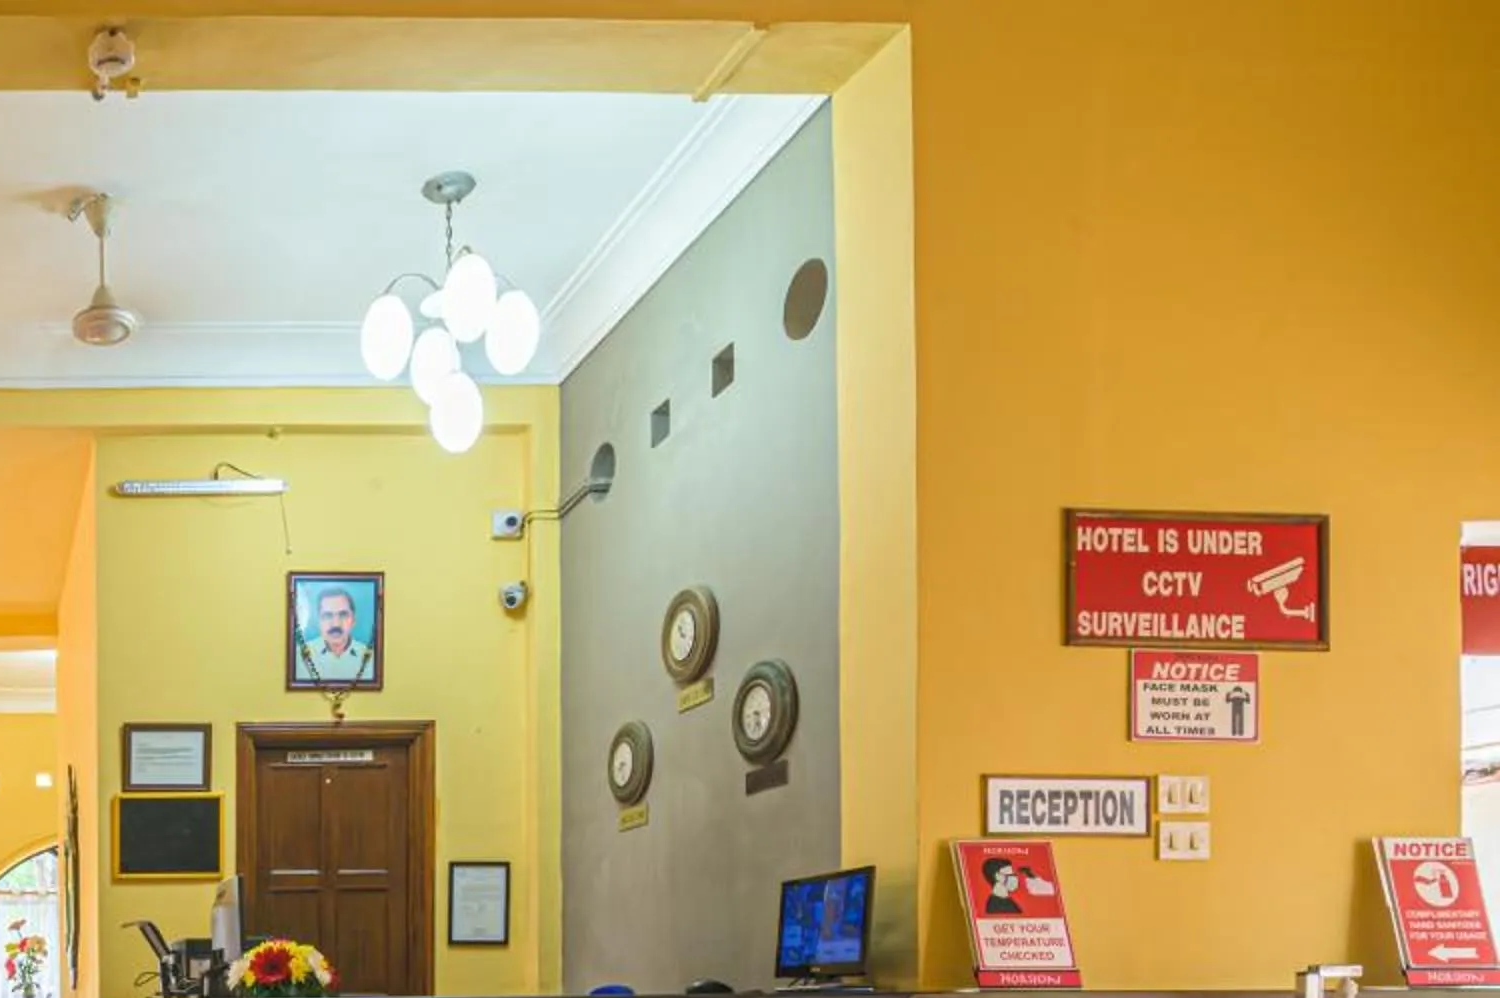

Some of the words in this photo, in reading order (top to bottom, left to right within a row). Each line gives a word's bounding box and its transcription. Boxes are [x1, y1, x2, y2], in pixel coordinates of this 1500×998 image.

[1077, 526, 1149, 553] HOTEL
[1157, 528, 1179, 554] IS
[1187, 530, 1263, 556] UNDER
[1142, 571, 1203, 597] CCTV
[1463, 563, 1500, 597] RIG
[1077, 610, 1246, 639] SURVEILLANCE
[1152, 661, 1241, 681] NOTICE
[1143, 683, 1176, 693] FACE
[1179, 683, 1219, 693] MASK
[1151, 697, 1188, 707] MUST
[1193, 697, 1211, 707] BE
[1150, 711, 1190, 721] WORN
[1193, 711, 1211, 721] AT
[1146, 725, 1172, 735] ALL
[1175, 725, 1216, 735] TIMES
[999, 789, 1135, 826] RECEPTION
[1393, 842, 1468, 857] NOTICE
[993, 923, 1014, 934] GET
[1020, 923, 1051, 934] YOUR
[983, 937, 1066, 948] TEMPERATURE
[999, 951, 1055, 961] CHECKED
